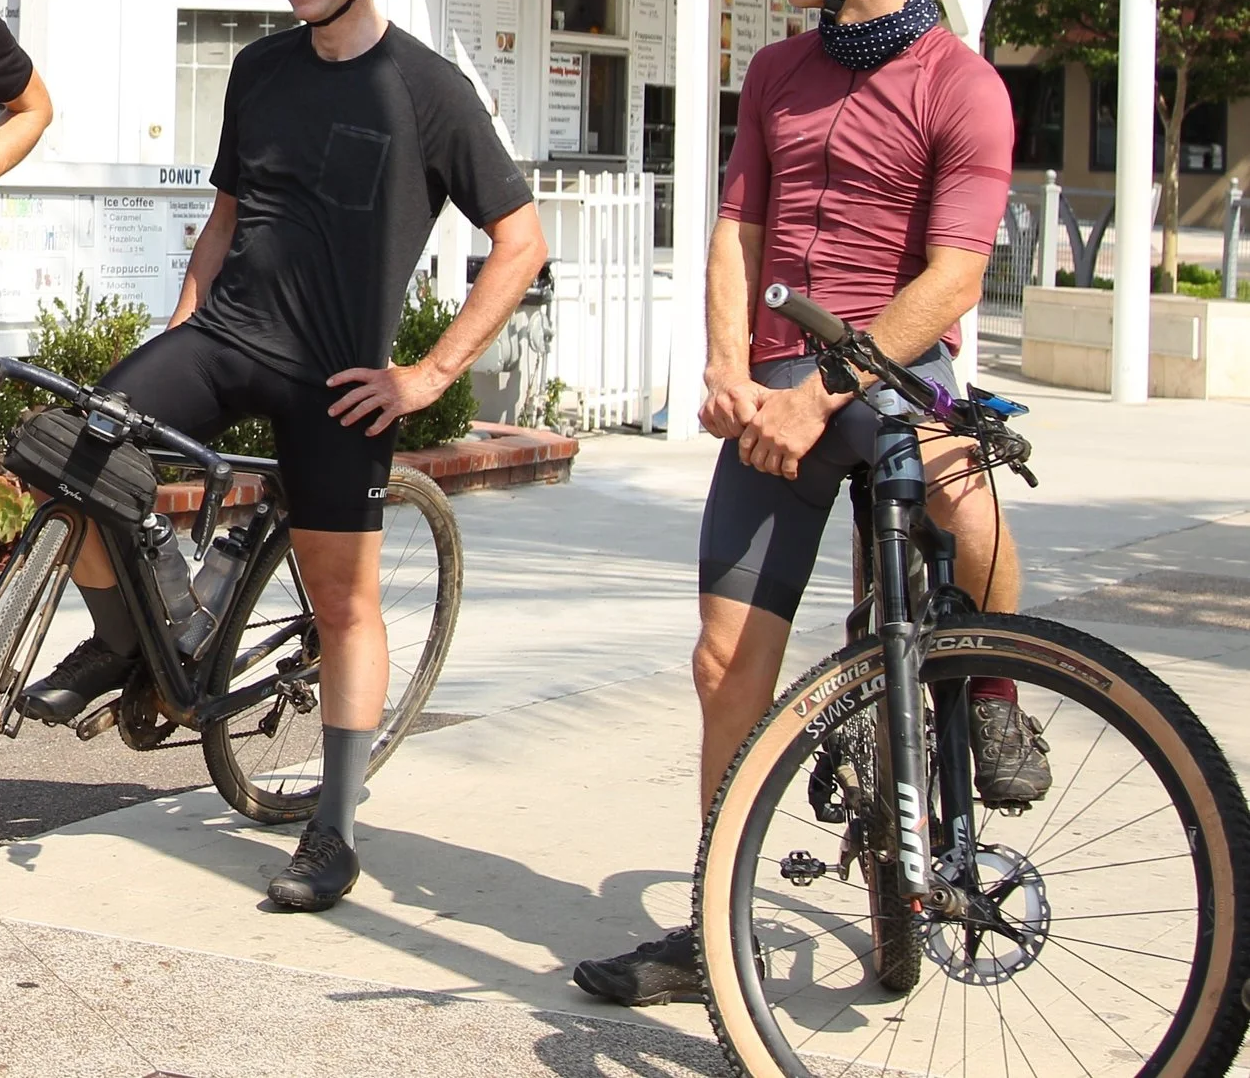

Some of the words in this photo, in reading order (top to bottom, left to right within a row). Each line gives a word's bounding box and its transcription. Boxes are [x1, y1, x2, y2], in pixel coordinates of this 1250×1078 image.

[104, 197, 119, 207] Ice
[121, 196, 155, 208] Coffee
[109, 213, 141, 222] Caramel
[109, 224, 135, 232] French
[138, 224, 162, 232] Vanilla
[100, 264, 159, 275] Frappuccino
[106, 281, 136, 290] Mocha
[810, 662, 871, 703] vittoria
[860, 673, 886, 701] DT
[805, 692, 855, 739] SWISS
